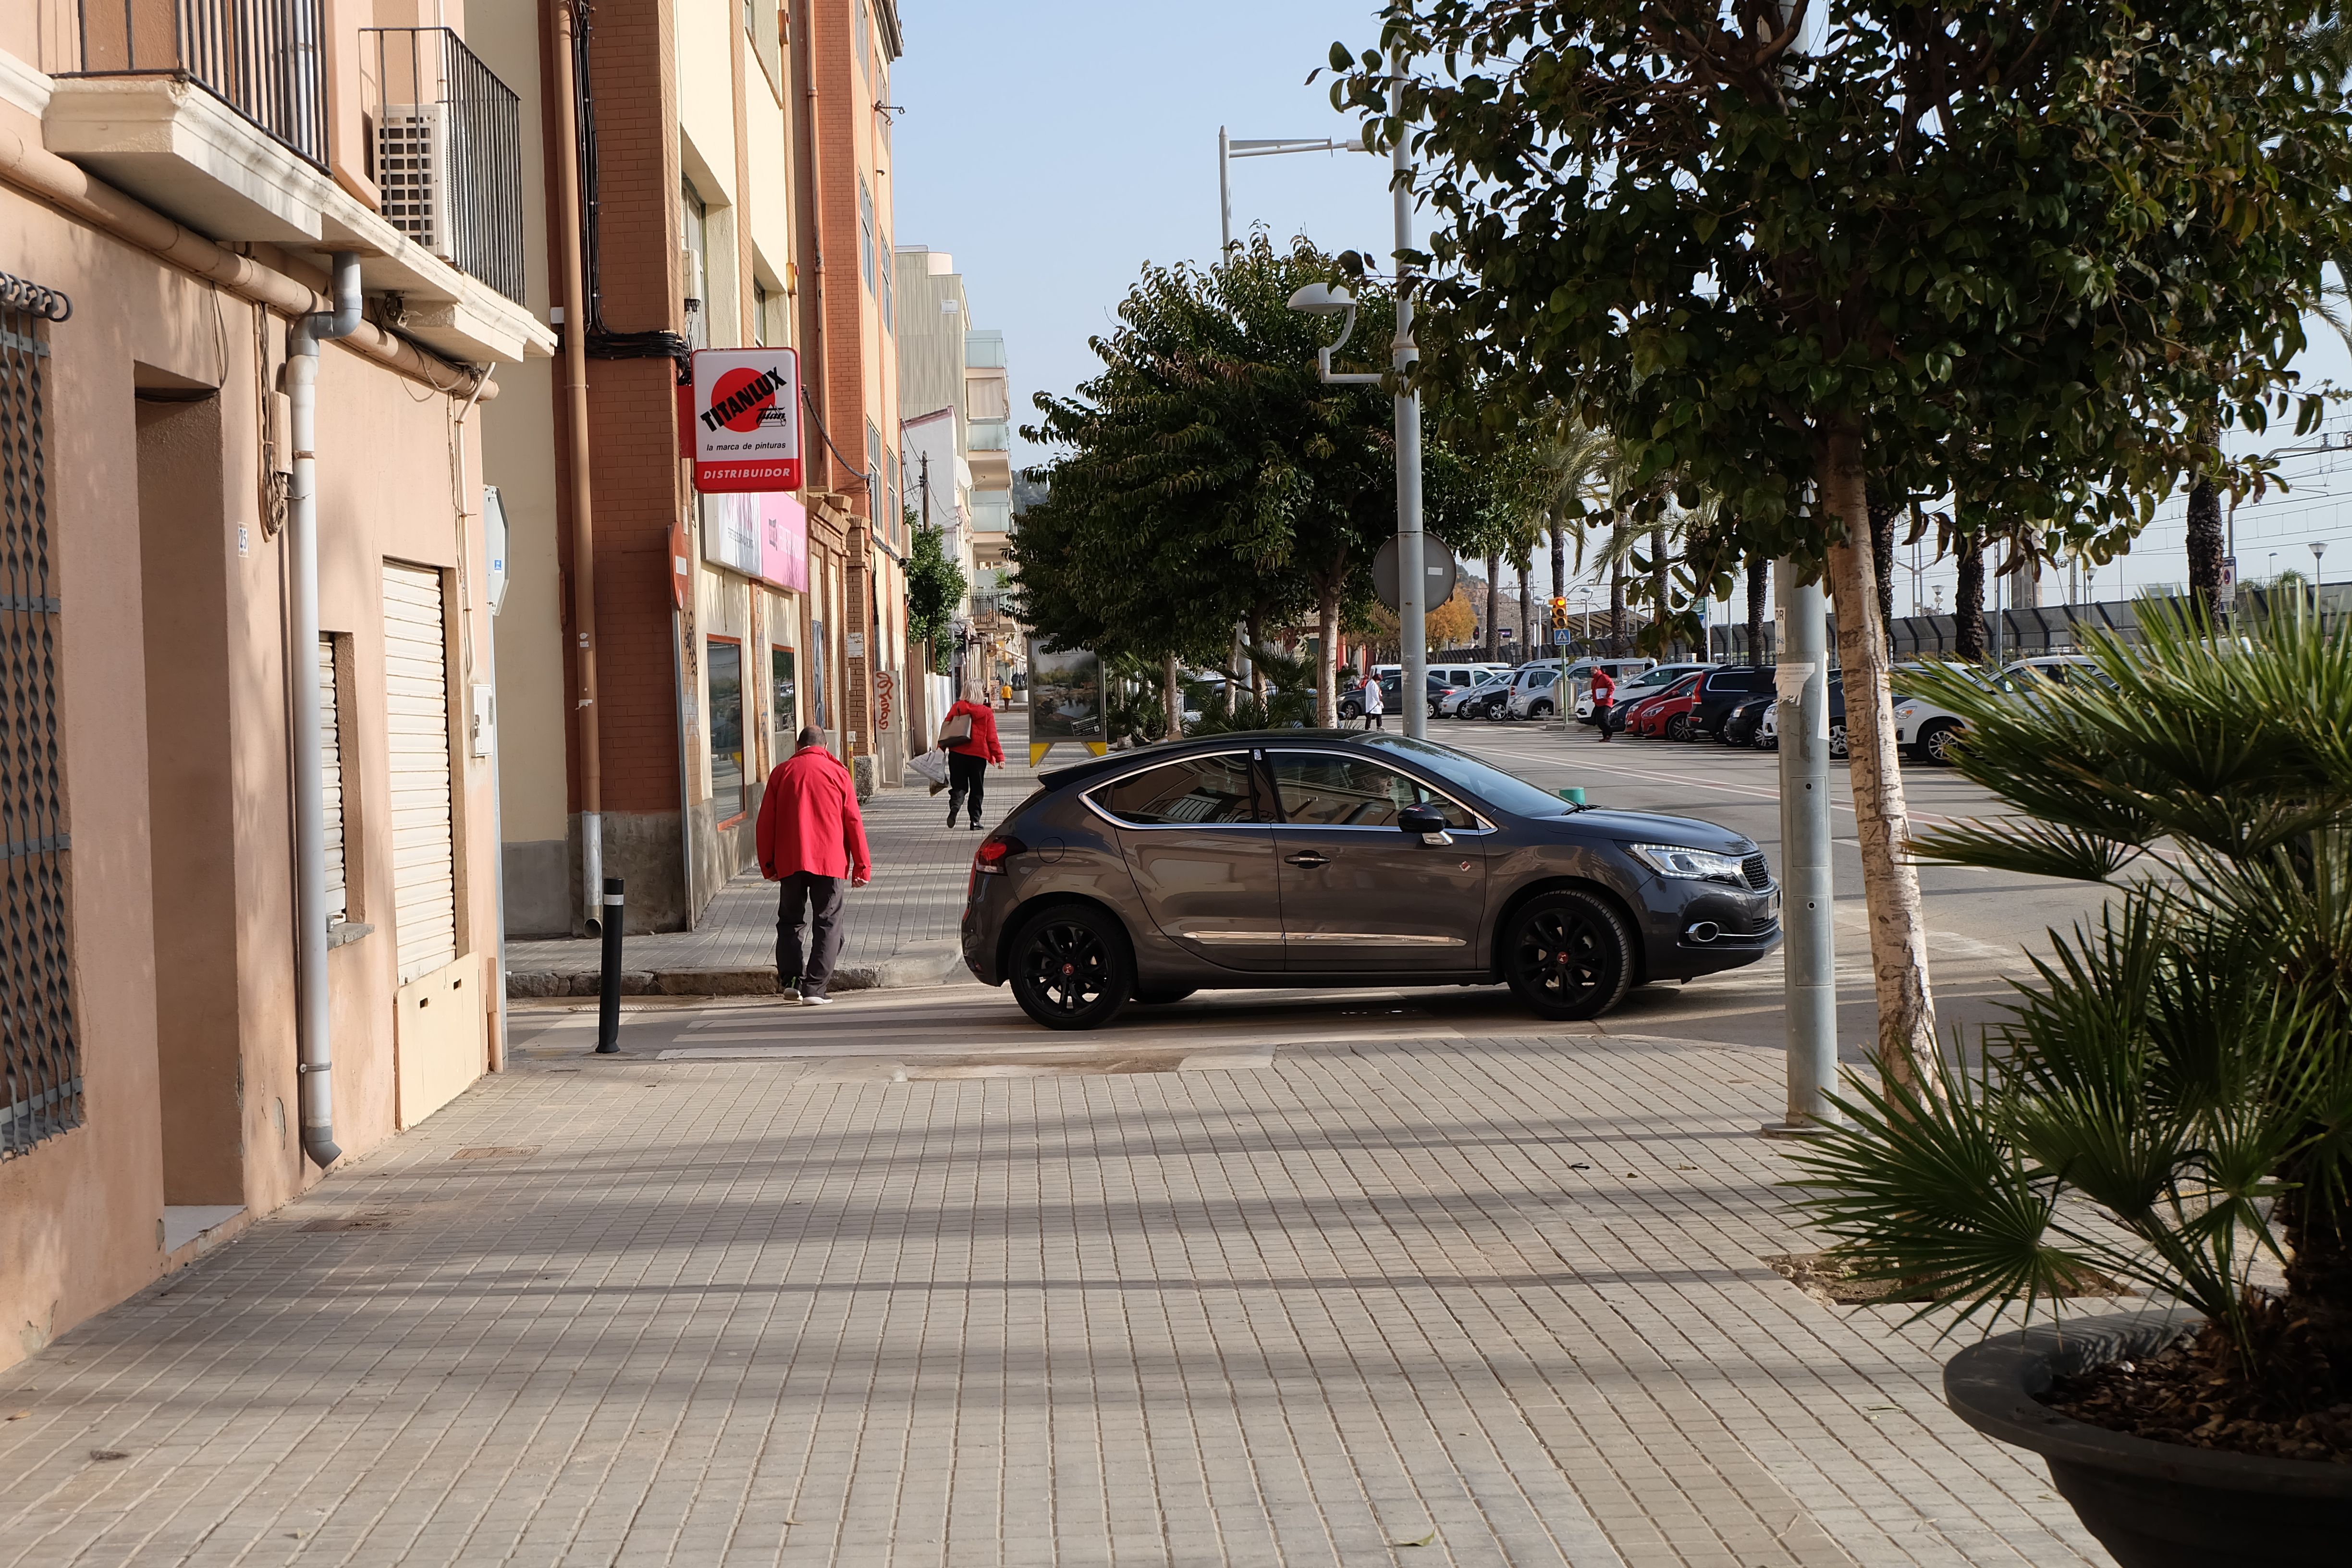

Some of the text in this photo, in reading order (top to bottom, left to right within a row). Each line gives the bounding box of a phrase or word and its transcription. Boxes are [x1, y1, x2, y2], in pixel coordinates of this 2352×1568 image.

[700, 367, 787, 432] TITANLUX
[755, 442, 786, 451] pinturas
[703, 468, 790, 479] DISTRIBUIDOR
[239, 529, 247, 549] 25
